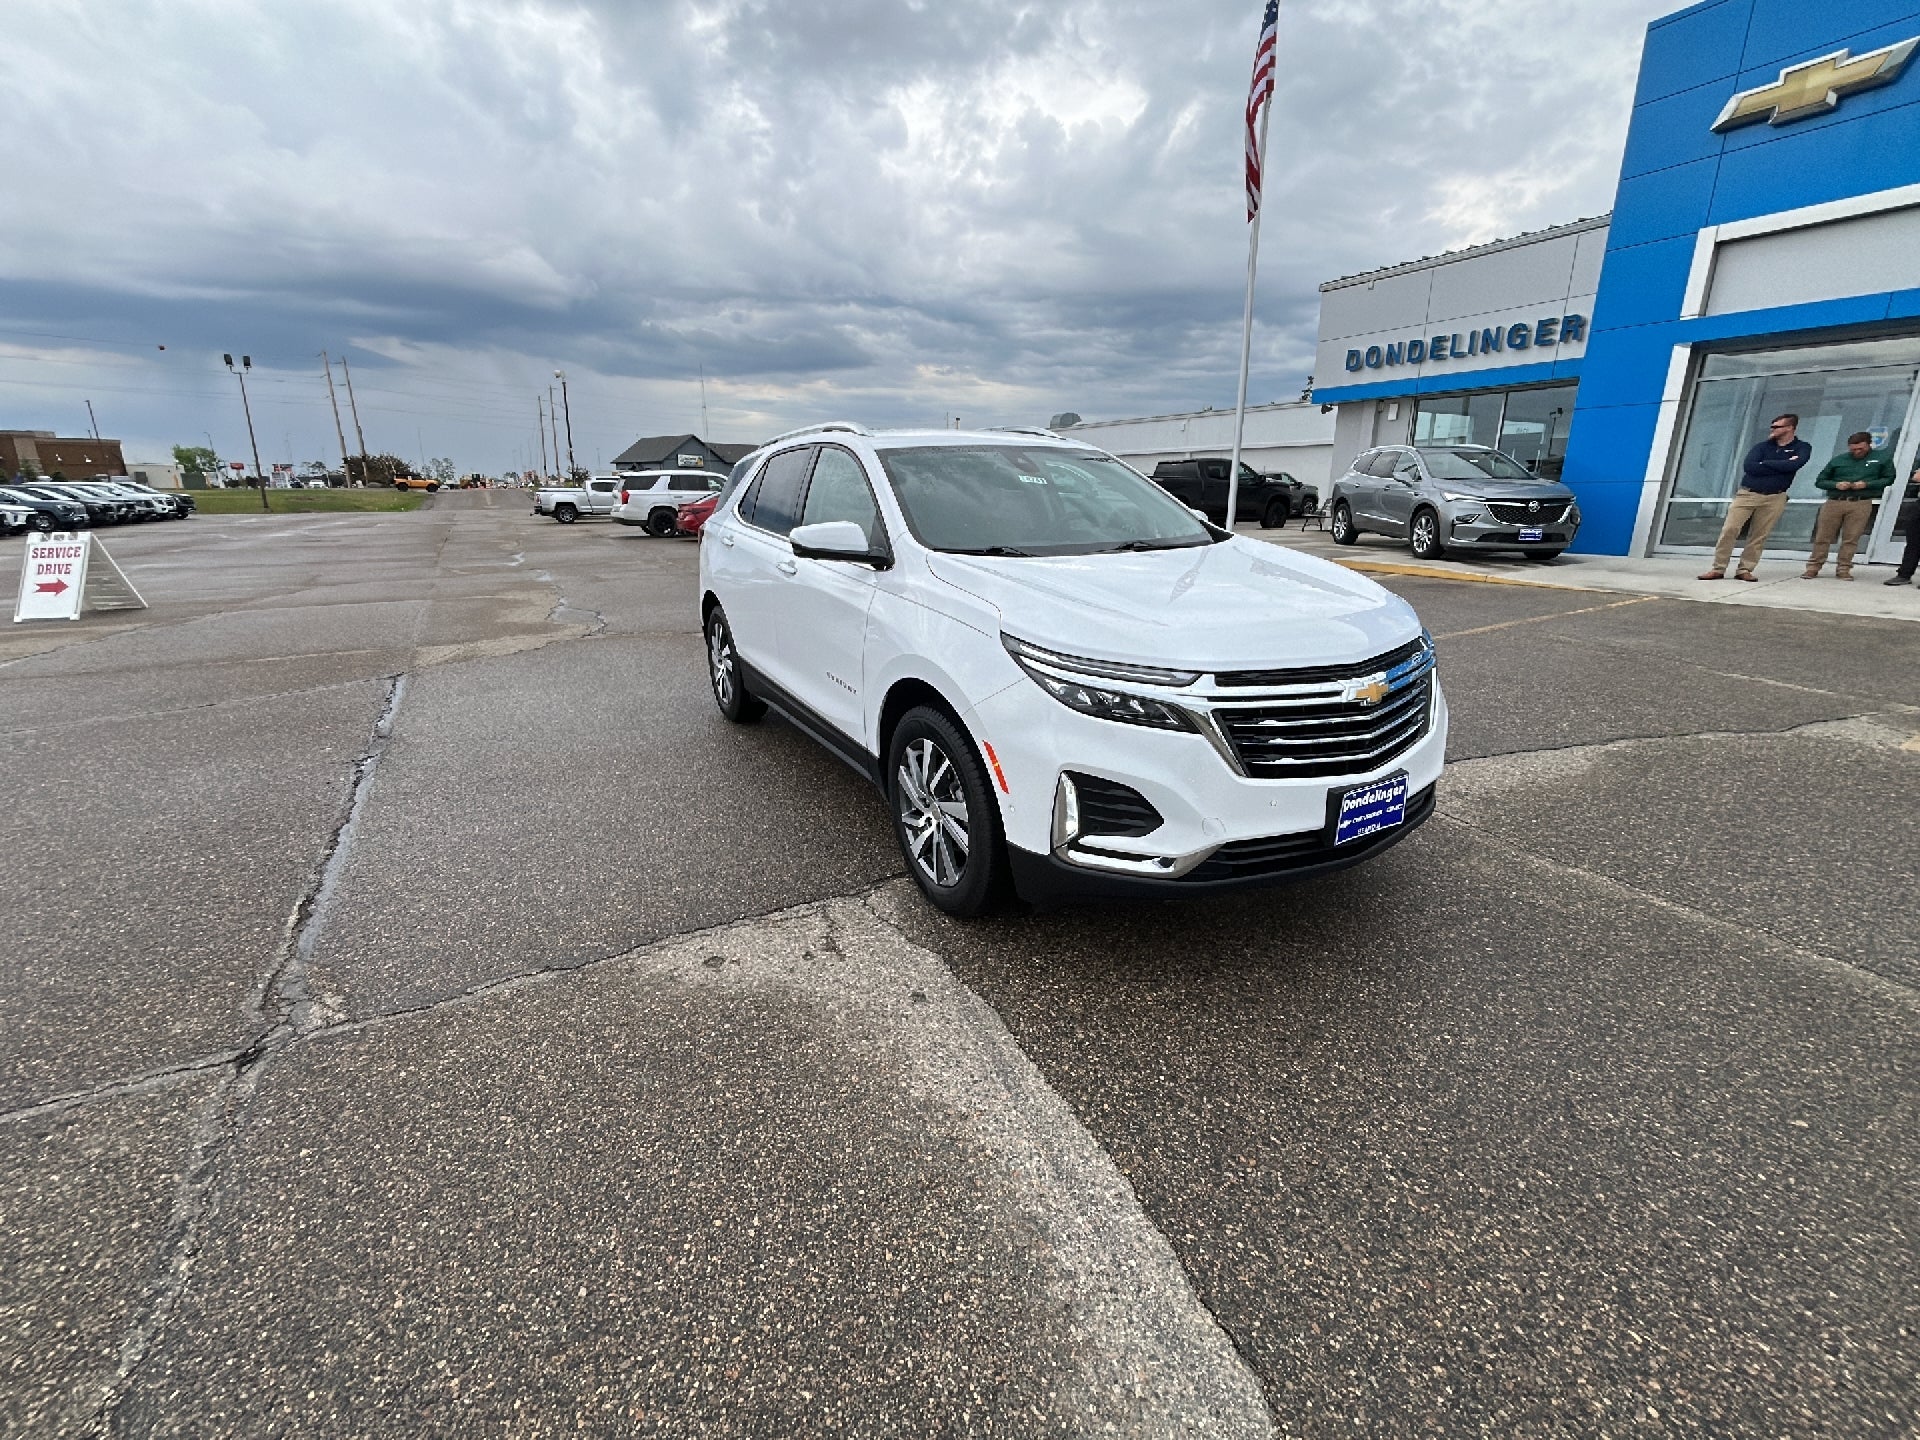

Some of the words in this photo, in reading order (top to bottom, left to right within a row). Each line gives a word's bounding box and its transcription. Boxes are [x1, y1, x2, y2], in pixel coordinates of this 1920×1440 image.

[1345, 314, 1586, 373] DONDELINGER
[32, 546, 82, 558] SERVICE
[37, 563, 72, 575] DRIVE
[1343, 786, 1404, 812] Dondelinger
